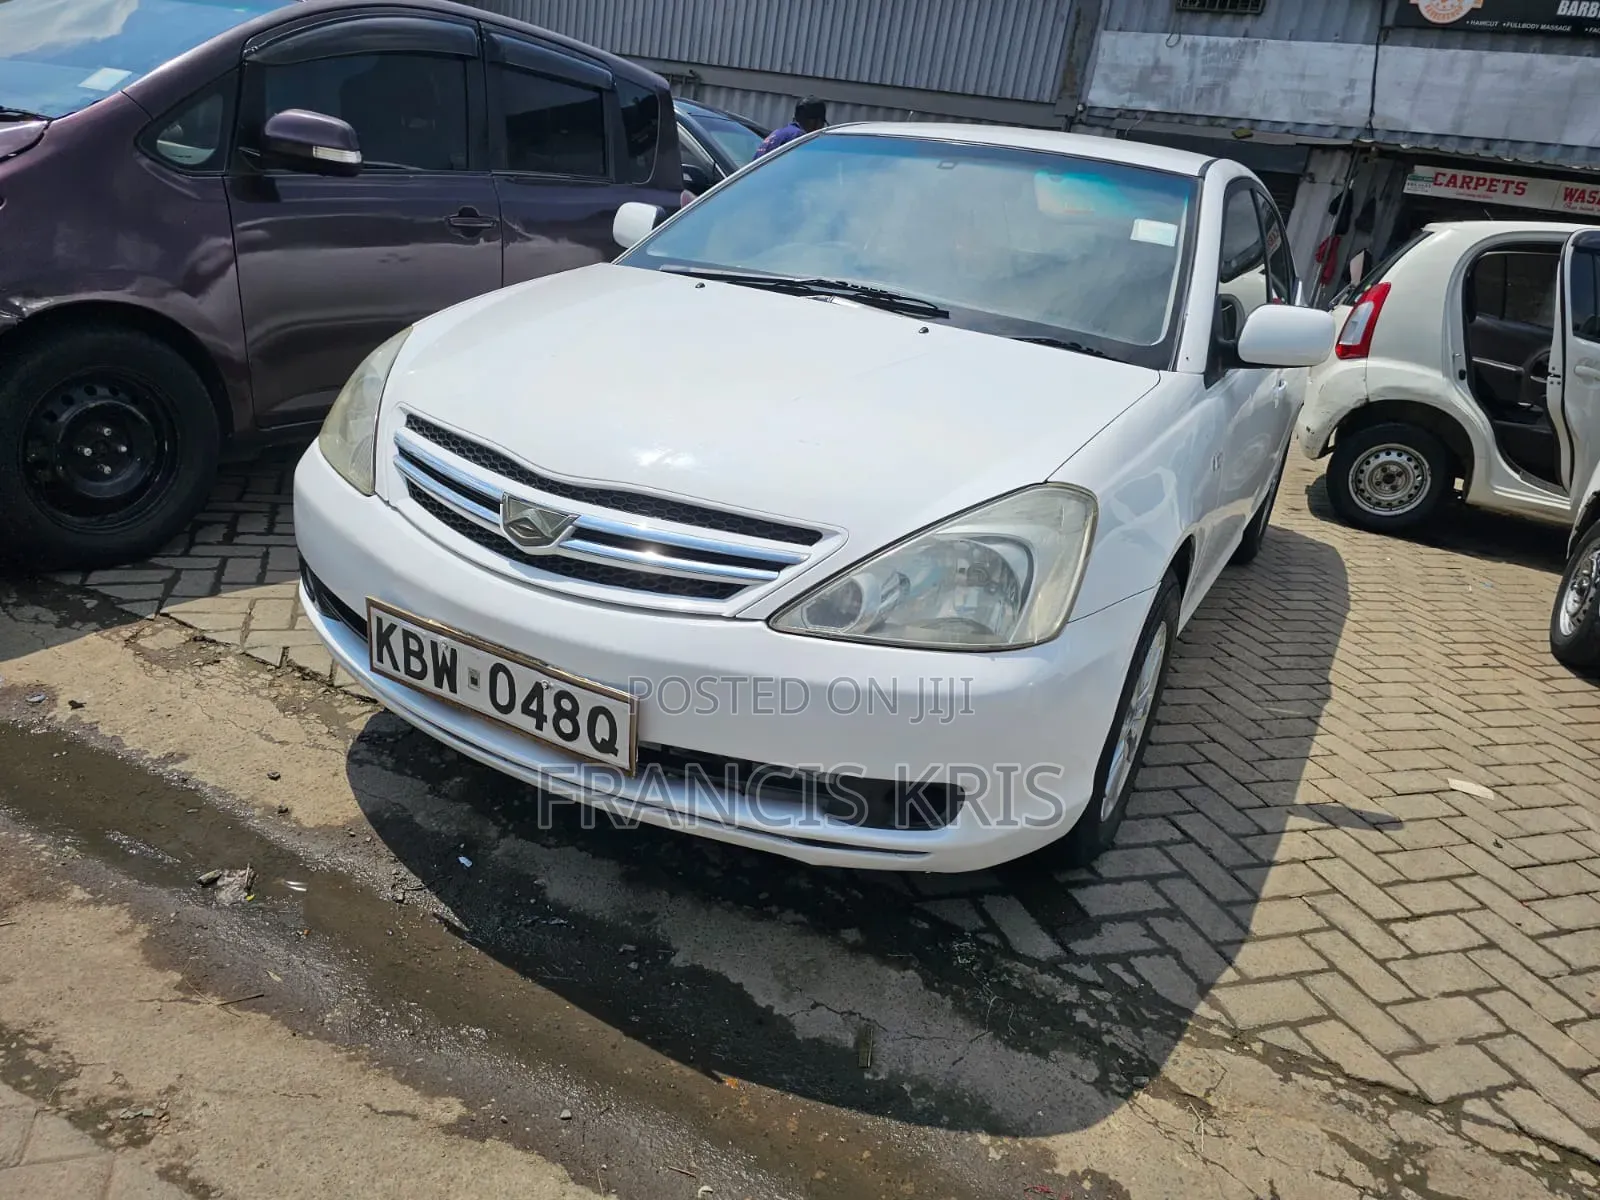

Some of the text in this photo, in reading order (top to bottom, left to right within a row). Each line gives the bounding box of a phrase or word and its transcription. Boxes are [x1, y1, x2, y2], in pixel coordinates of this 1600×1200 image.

[1556, 0, 1600, 18] BARB
[1433, 172, 1528, 196] CARPETS
[376, 616, 619, 758] KBW 048Q
